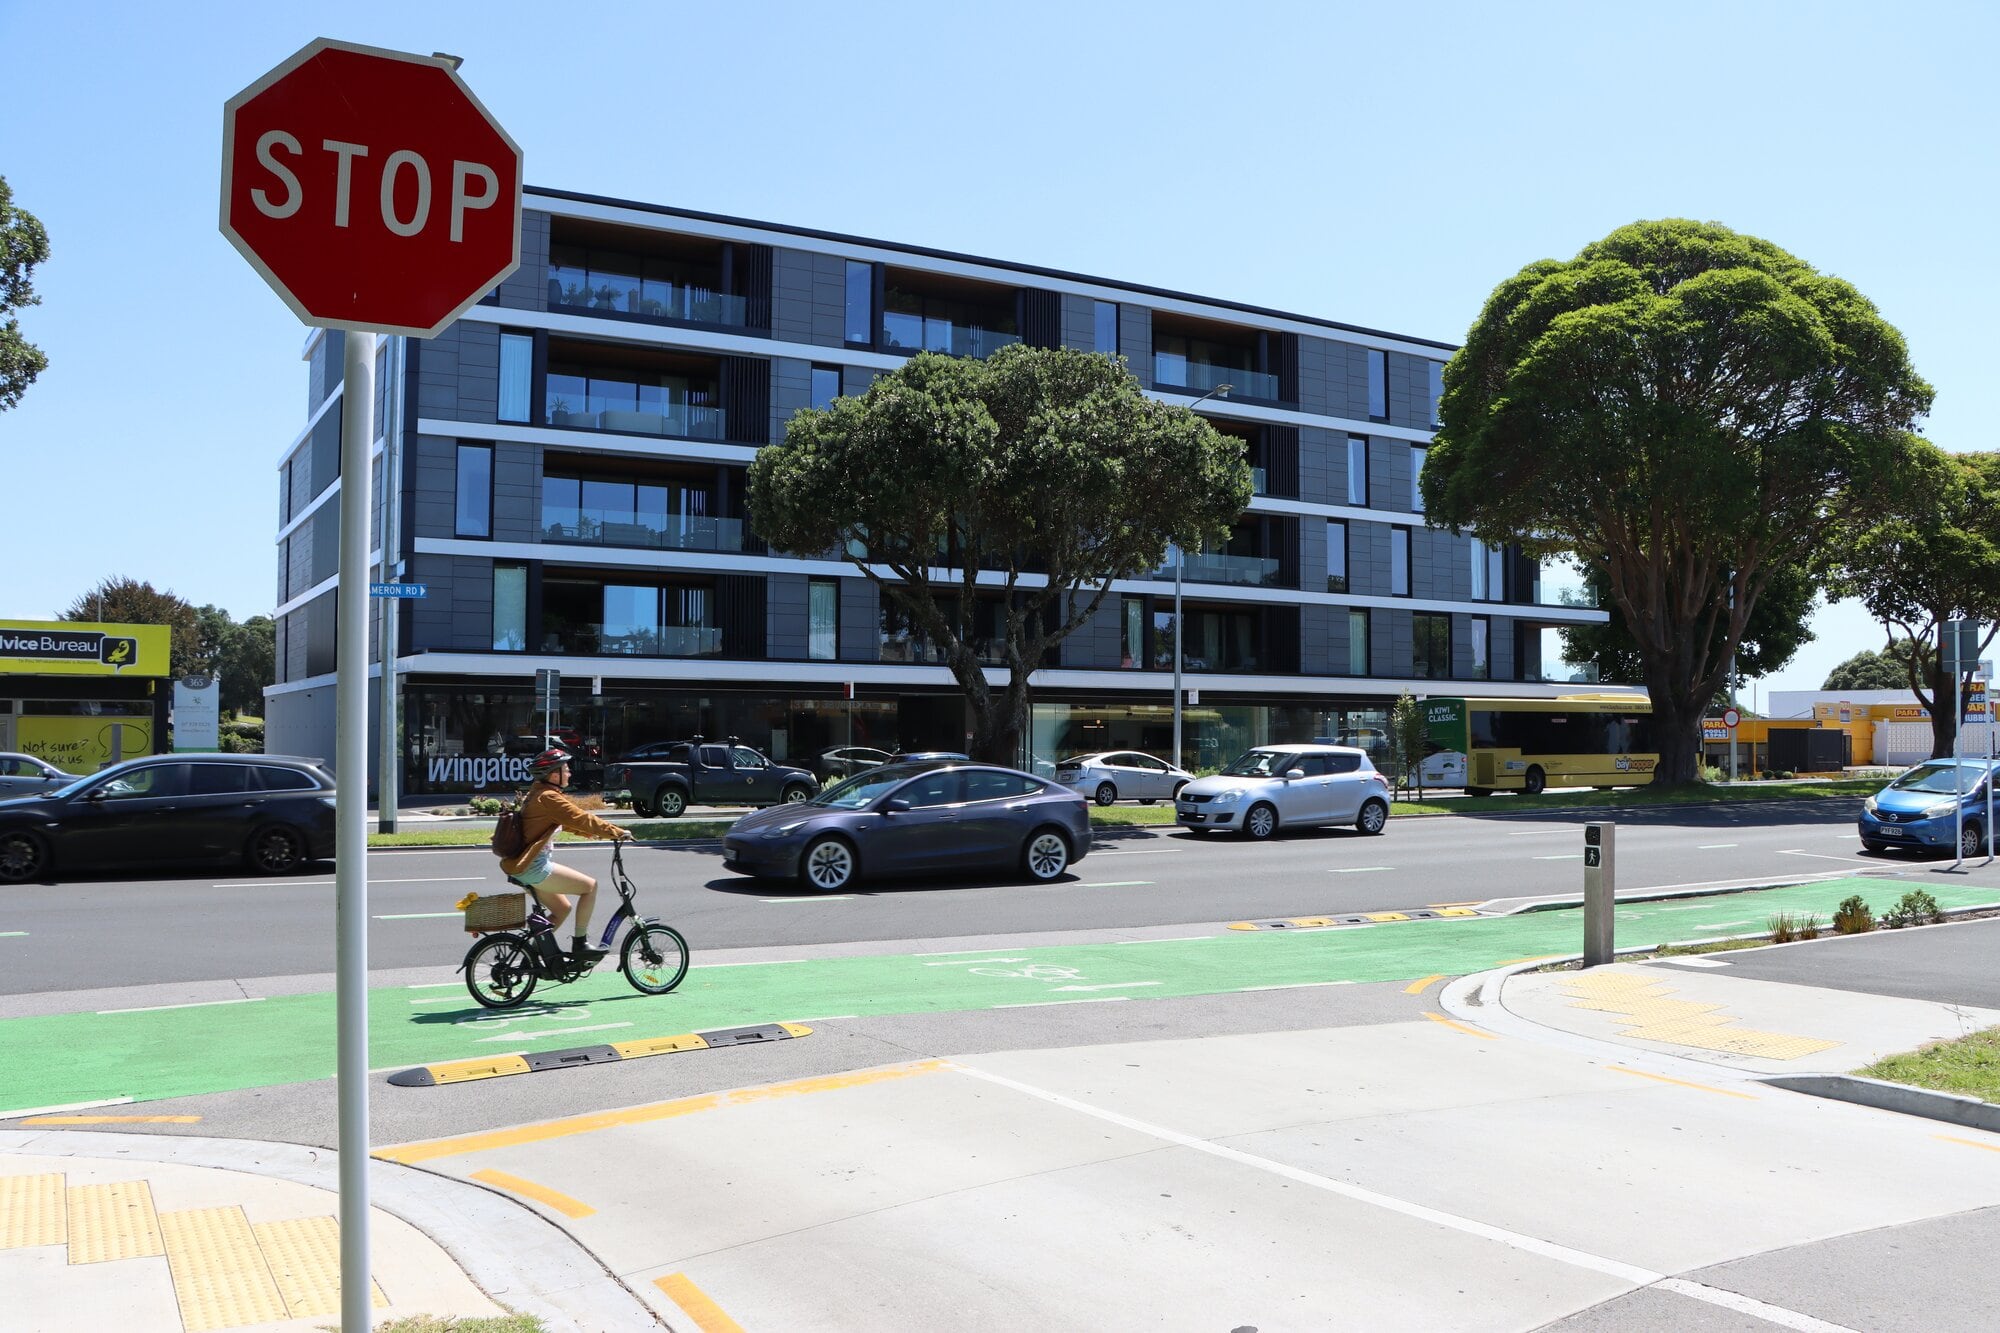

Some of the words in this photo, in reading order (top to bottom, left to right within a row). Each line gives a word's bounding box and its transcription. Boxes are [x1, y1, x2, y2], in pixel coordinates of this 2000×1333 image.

[250, 129, 499, 243] STOP
[369, 585, 401, 595] MERON
[405, 586, 418, 596] RD
[40, 636, 98, 652] Bureau
[190, 678, 204, 687] 365
[1434, 706, 1450, 714] KIWI
[1429, 714, 1458, 722] CLASSIC.
[1964, 713, 1994, 721] UBBR
[1703, 721, 1727, 729] PARA
[22, 740, 46, 753] Not
[50, 738, 89, 752] sure?
[428, 753, 534, 789] wingates
